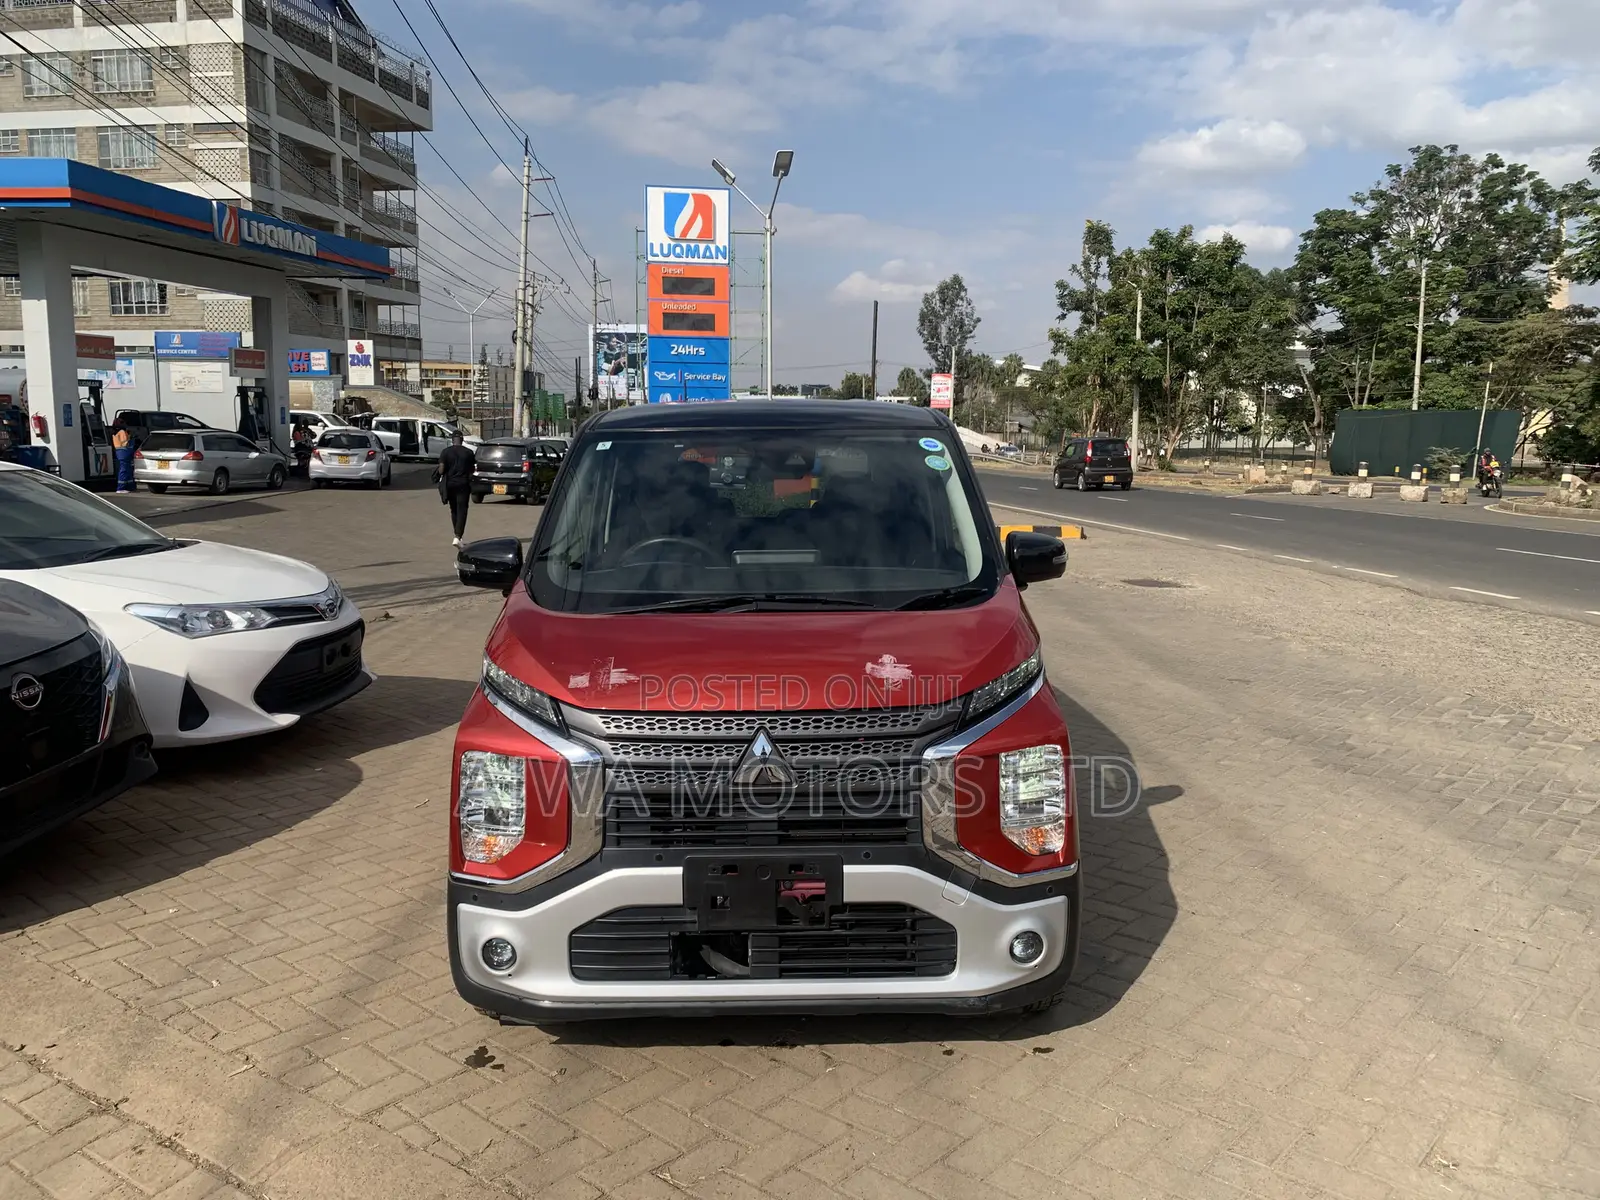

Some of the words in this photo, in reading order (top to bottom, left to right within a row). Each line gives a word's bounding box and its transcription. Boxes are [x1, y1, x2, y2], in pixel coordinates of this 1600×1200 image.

[240, 217, 317, 257] LUQMAN
[649, 242, 727, 260] LUQMAN
[661, 266, 684, 275] Diesel
[661, 302, 696, 311] Unleaded
[670, 344, 706, 356] 24Hrs
[349, 353, 372, 367] ZNK
[684, 372, 711, 381] Service
[712, 373, 727, 383] Bay
